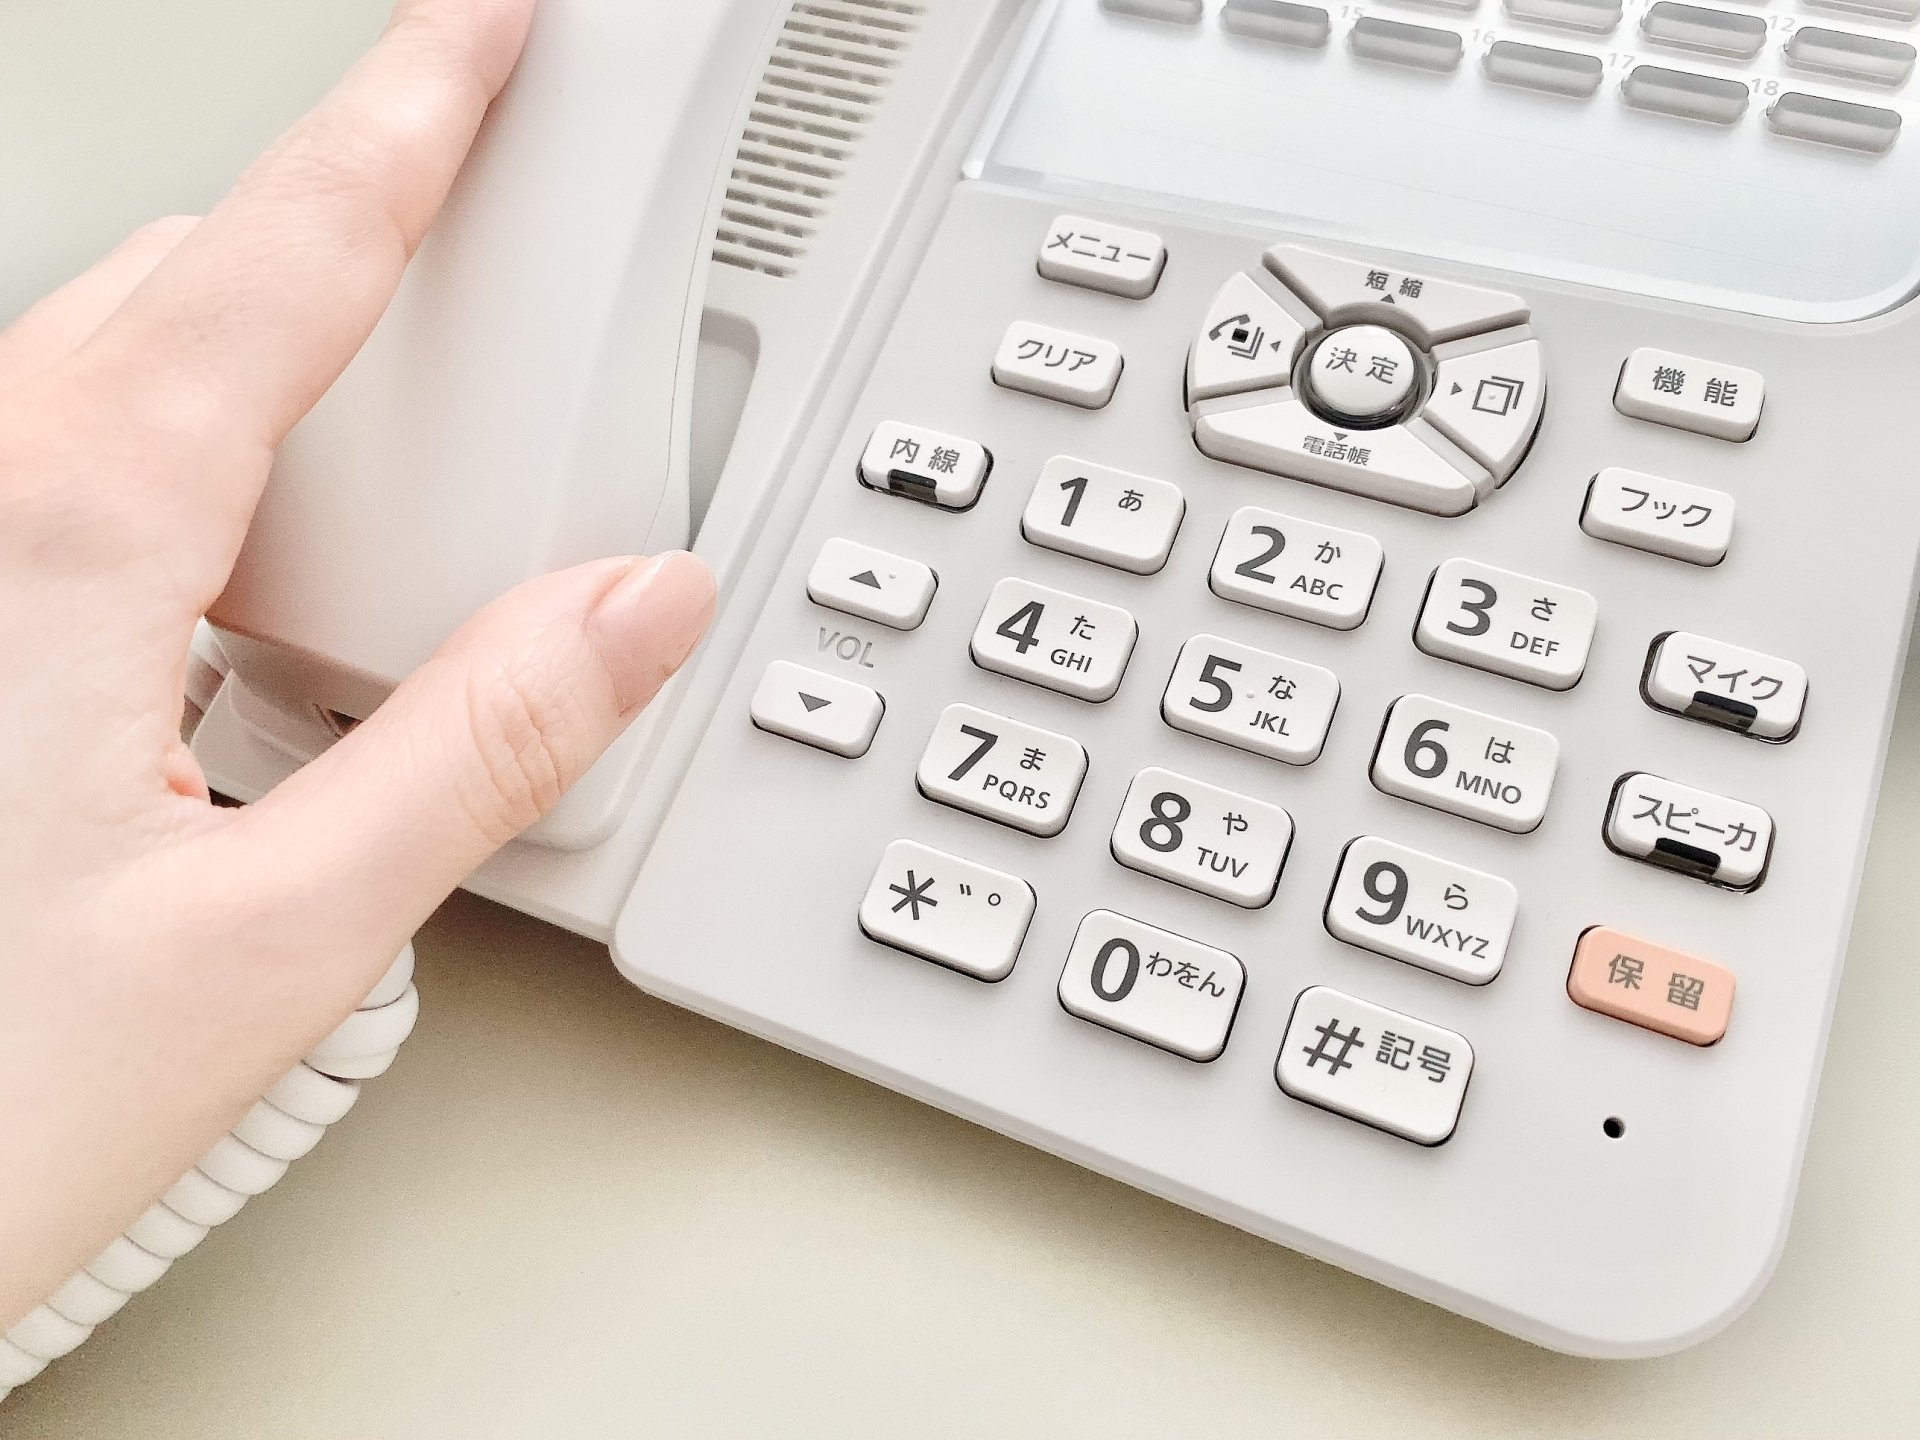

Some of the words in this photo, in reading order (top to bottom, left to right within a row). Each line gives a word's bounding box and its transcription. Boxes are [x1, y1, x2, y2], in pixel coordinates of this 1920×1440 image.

[1472, 28, 1496, 45] 16
[1768, 15, 1796, 32] 12
[1608, 53, 1635, 70] 17
[1751, 78, 1780, 96] 18
[1047, 232, 1151, 263] メニュー
[1364, 270, 1424, 299] 短縮
[1017, 339, 1098, 372] クリア
[1325, 346, 1399, 385] 決定
[1652, 366, 1738, 407] 機能
[889, 437, 962, 474] 内線
[1303, 435, 1372, 467] 電話帳
[1060, 477, 1089, 527] 1
[1118, 490, 1144, 512] あ
[1621, 486, 1712, 528] フック
[1234, 525, 1286, 585] 2
[1315, 542, 1341, 565] か
[1290, 575, 1343, 601] ABC
[1447, 579, 1498, 637] 3
[1531, 598, 1557, 622] さ
[816, 626, 875, 669] VOL
[996, 601, 1045, 655] 4
[1070, 616, 1096, 641] た
[1510, 632, 1560, 657] DEF
[1051, 649, 1093, 673] GHI
[1687, 655, 1783, 701] マイク
[1190, 655, 1243, 713] 5
[1269, 676, 1297, 700] な
[1250, 711, 1290, 737] JKL
[947, 723, 999, 782] 7
[1020, 748, 1047, 771] ま
[1404, 720, 1450, 779] 6
[1485, 737, 1515, 764] は
[982, 773, 1051, 810] PQRS
[1455, 770, 1522, 805] MNO
[1140, 792, 1192, 853] 8
[1223, 812, 1249, 836] や
[1632, 794, 1757, 852] スピーカ
[1198, 847, 1249, 878] TUV
[1355, 860, 1409, 925] 9
[1444, 884, 1469, 911] ら
[1406, 914, 1490, 959] WXYZ
[1091, 938, 1141, 1003] 0
[1145, 951, 1226, 999] わをん
[1608, 953, 1705, 1011] 保留
[1376, 1031, 1451, 1084] 記号
